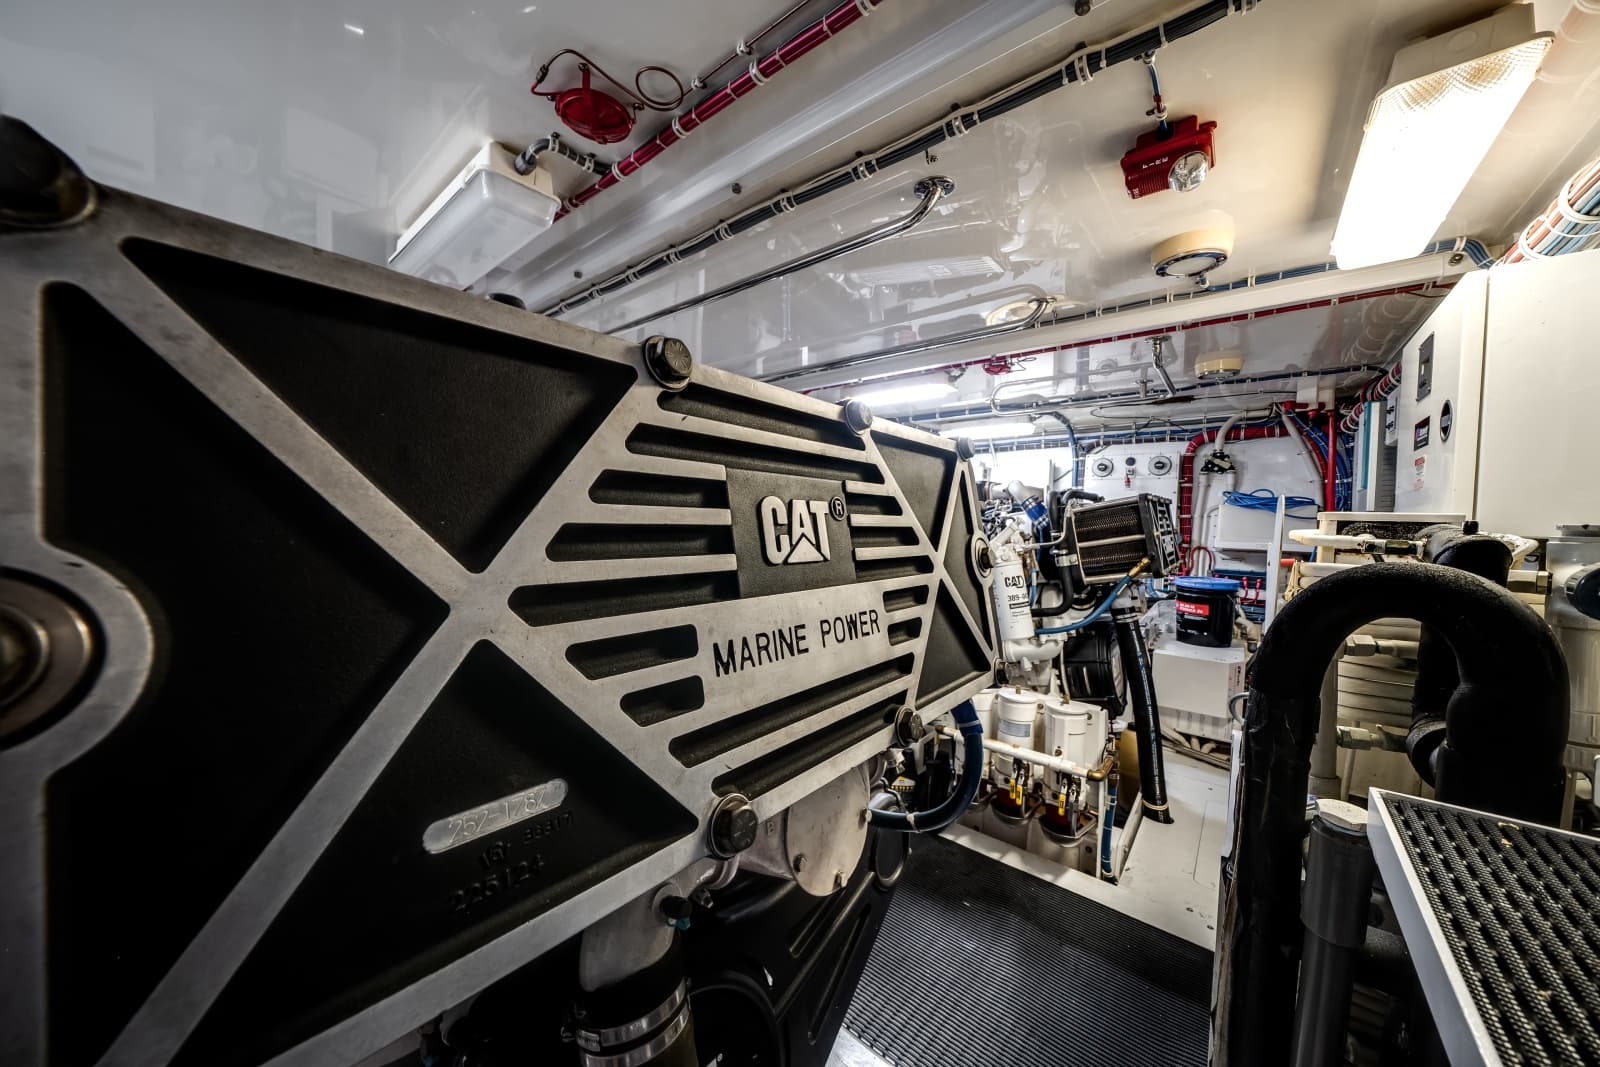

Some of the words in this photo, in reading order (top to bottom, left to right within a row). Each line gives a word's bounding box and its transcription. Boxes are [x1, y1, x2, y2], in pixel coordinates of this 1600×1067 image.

[1004, 575, 1024, 588] CAT
[712, 623, 809, 677] MARINE
[820, 609, 881, 648] POWER
